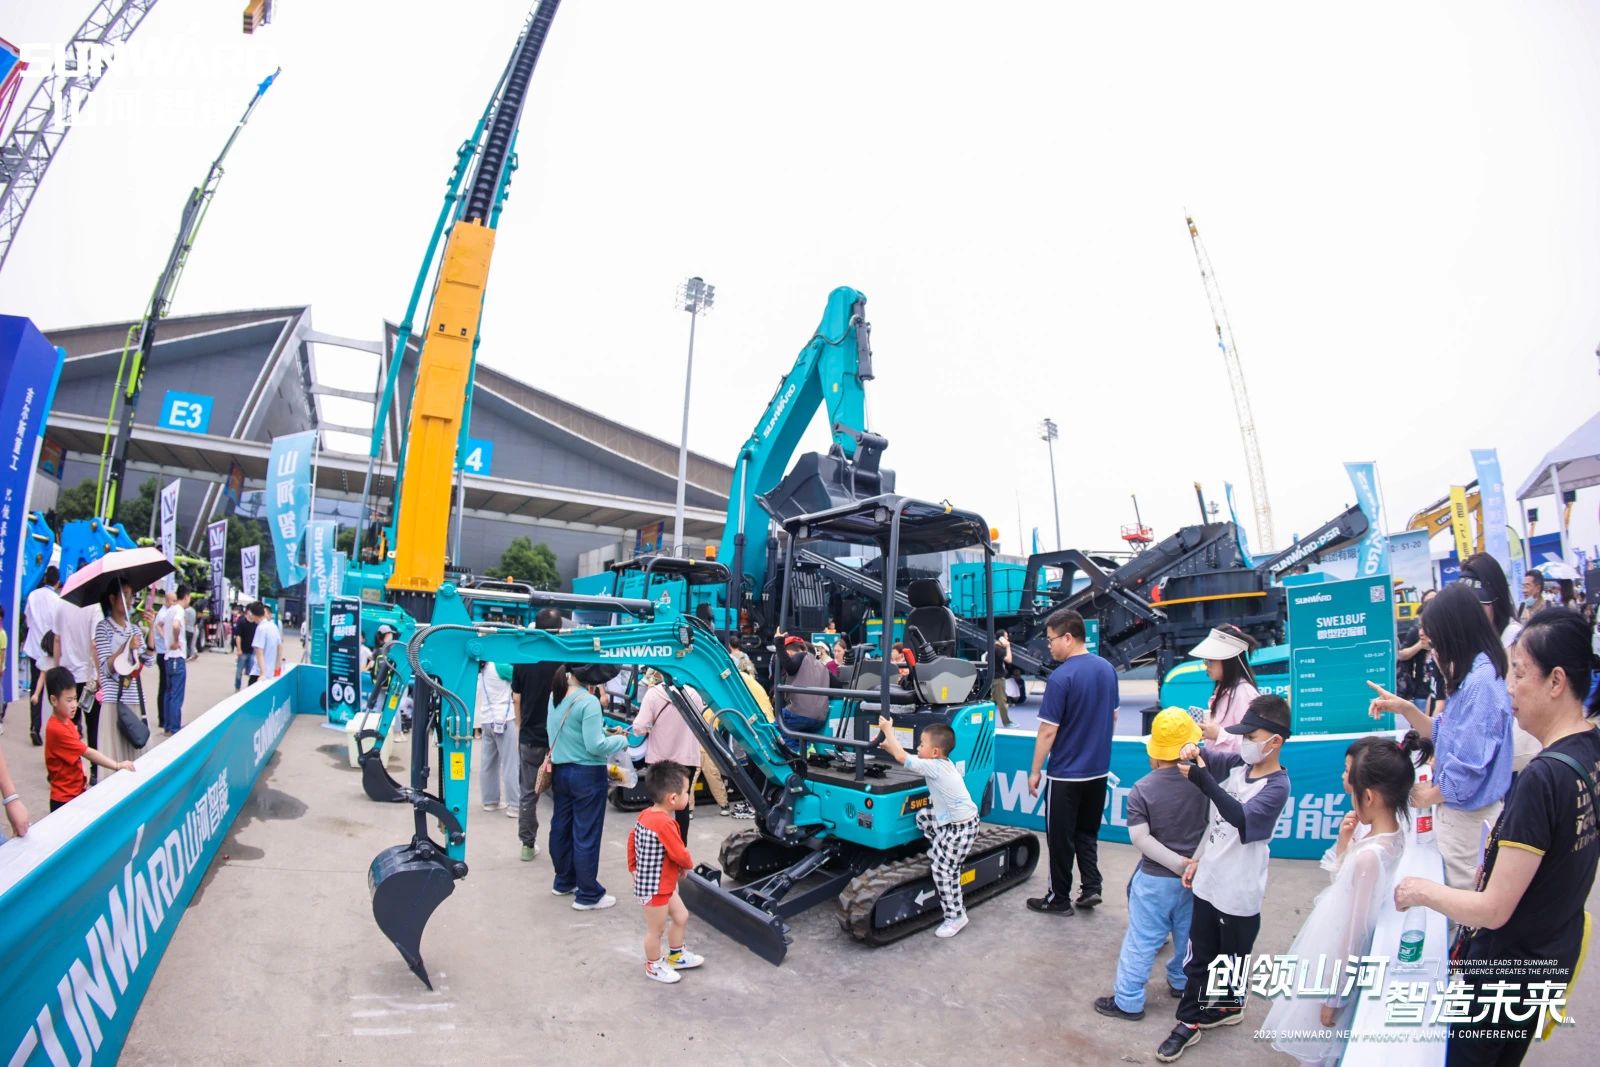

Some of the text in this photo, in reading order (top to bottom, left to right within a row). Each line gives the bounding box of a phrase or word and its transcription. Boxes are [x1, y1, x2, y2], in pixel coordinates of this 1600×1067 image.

[168, 400, 203, 430] E3
[763, 383, 796, 439] SUNWARD
[1295, 592, 1333, 605] SUNWARD
[1316, 612, 1367, 628] SWE18UF
[599, 639, 673, 658] SUNWARD
